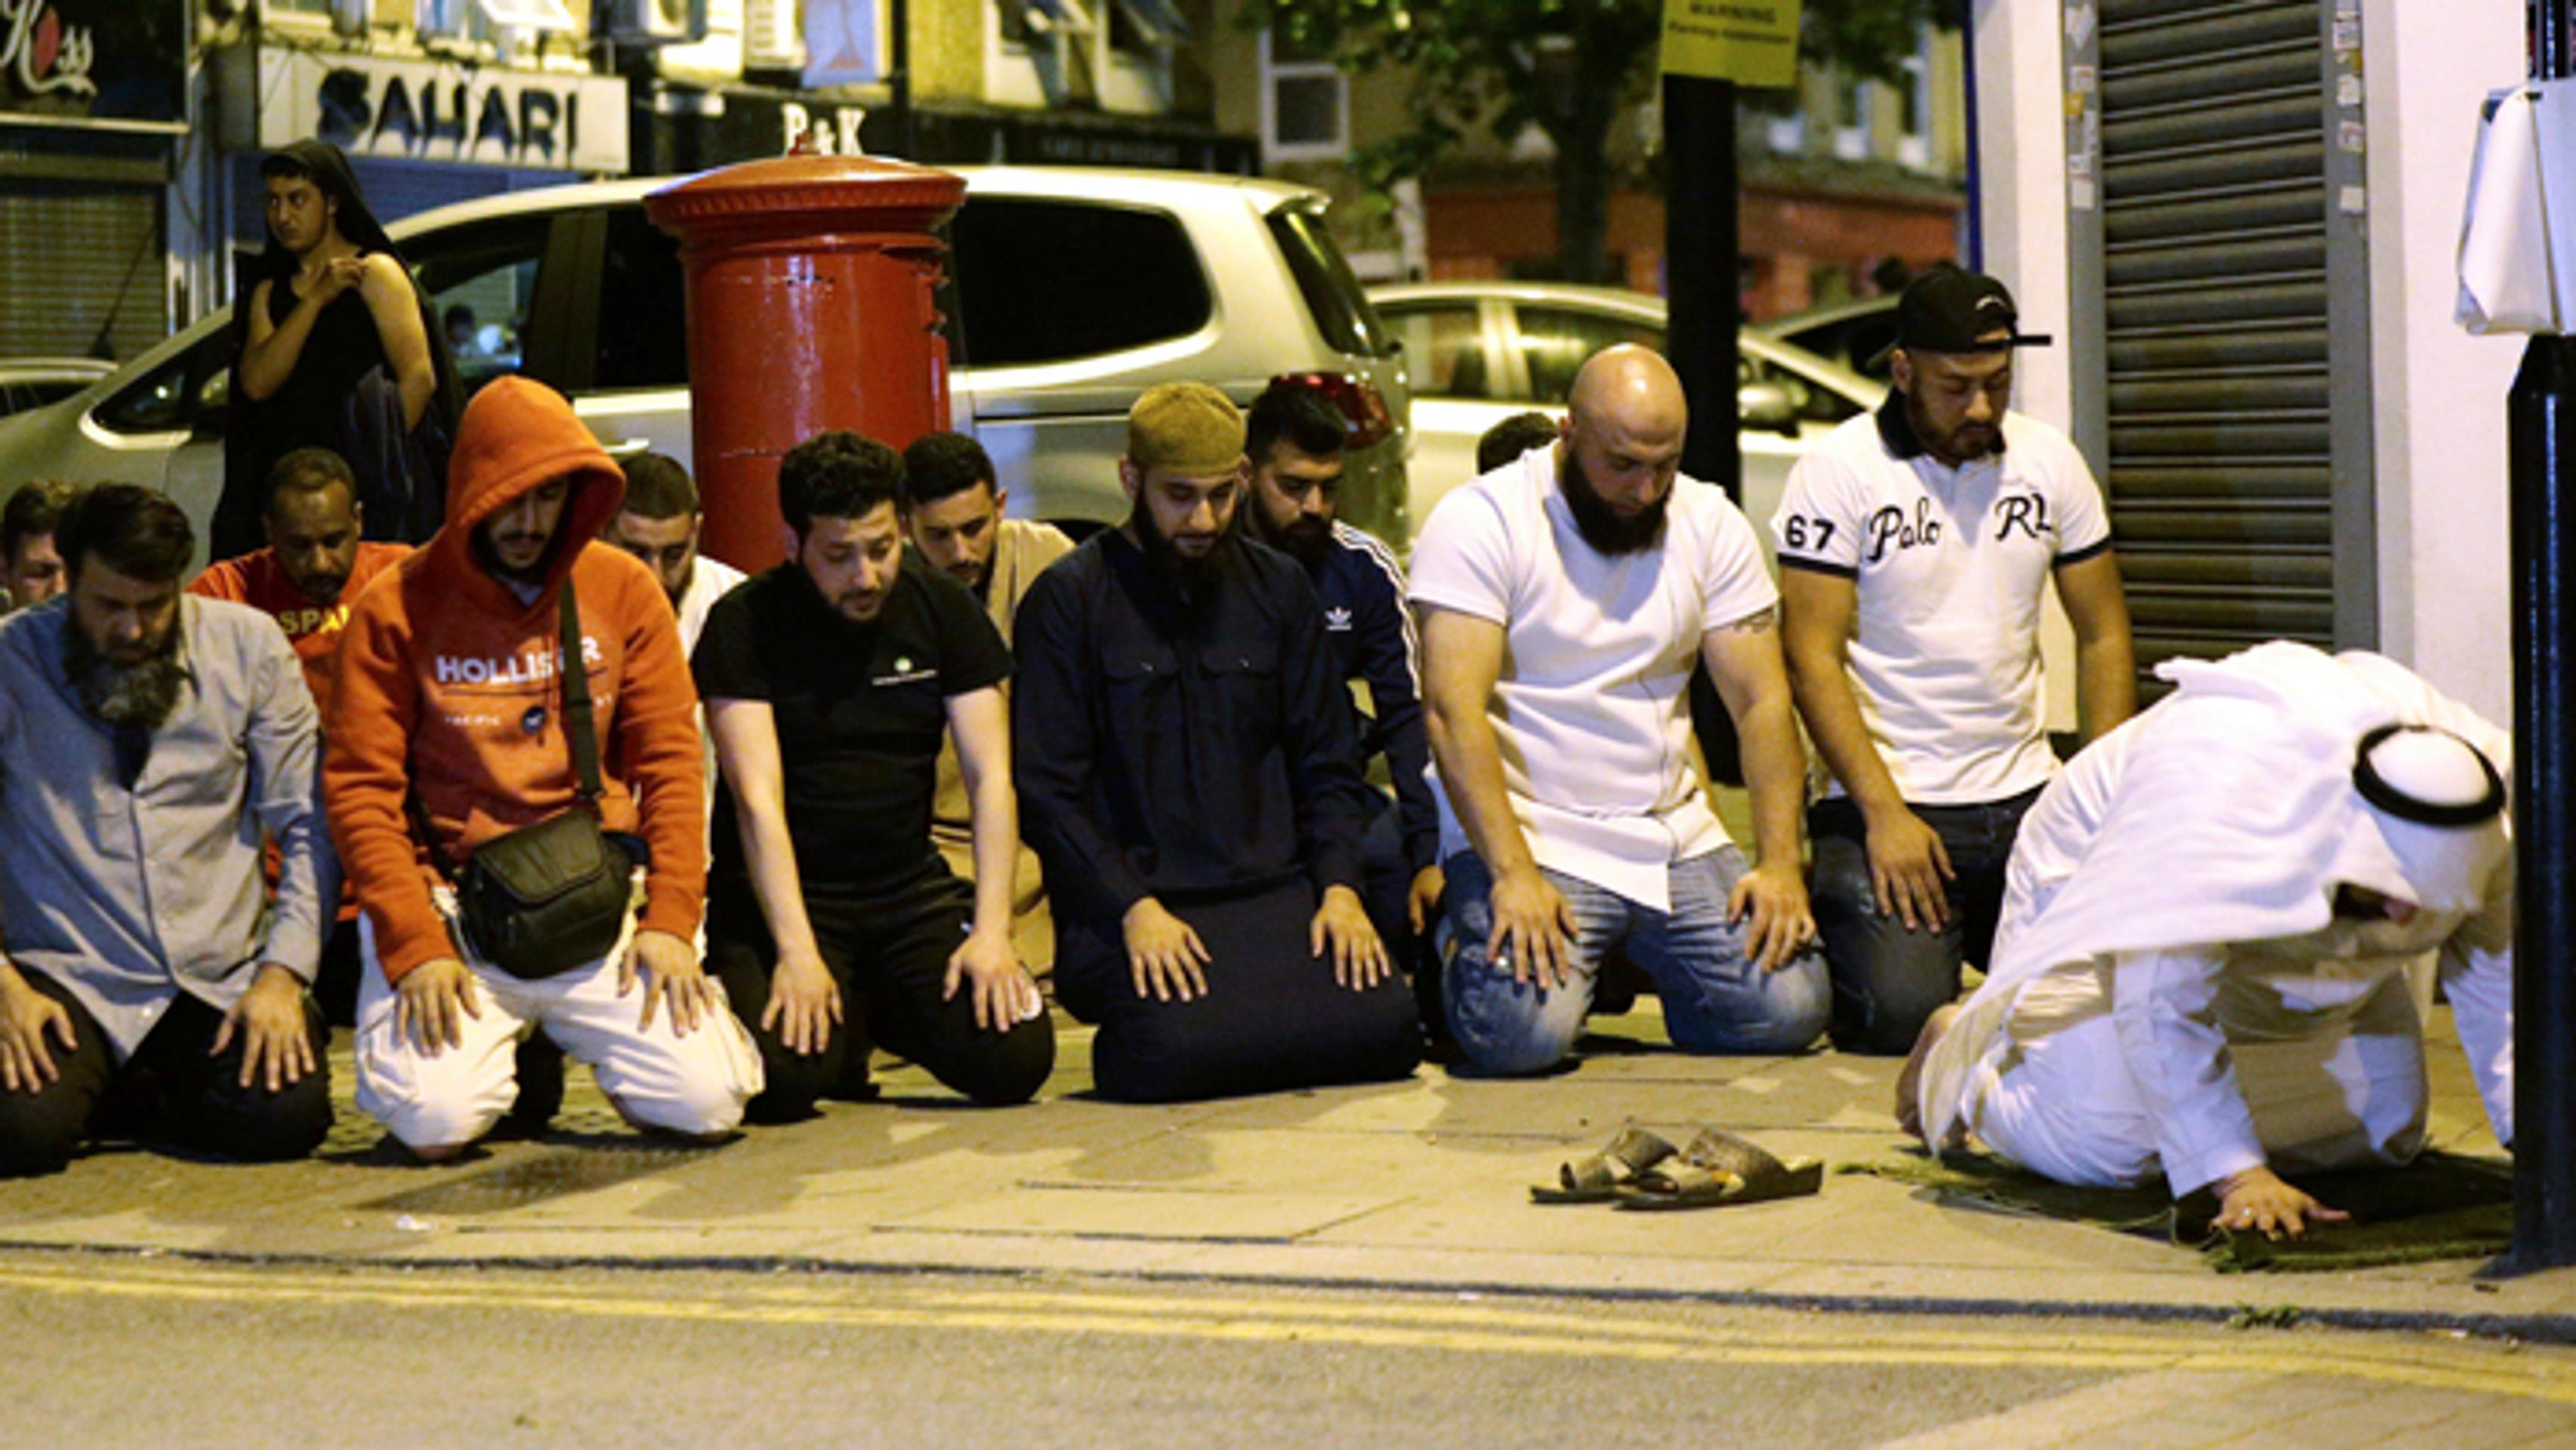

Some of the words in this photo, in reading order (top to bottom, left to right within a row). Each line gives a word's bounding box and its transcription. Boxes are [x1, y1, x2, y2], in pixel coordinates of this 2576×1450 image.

[317, 67, 578, 166] SAHARI
[1785, 514, 1836, 551] 67
[1867, 496, 1943, 563] Polo
[435, 635, 603, 684] HOLLISR
